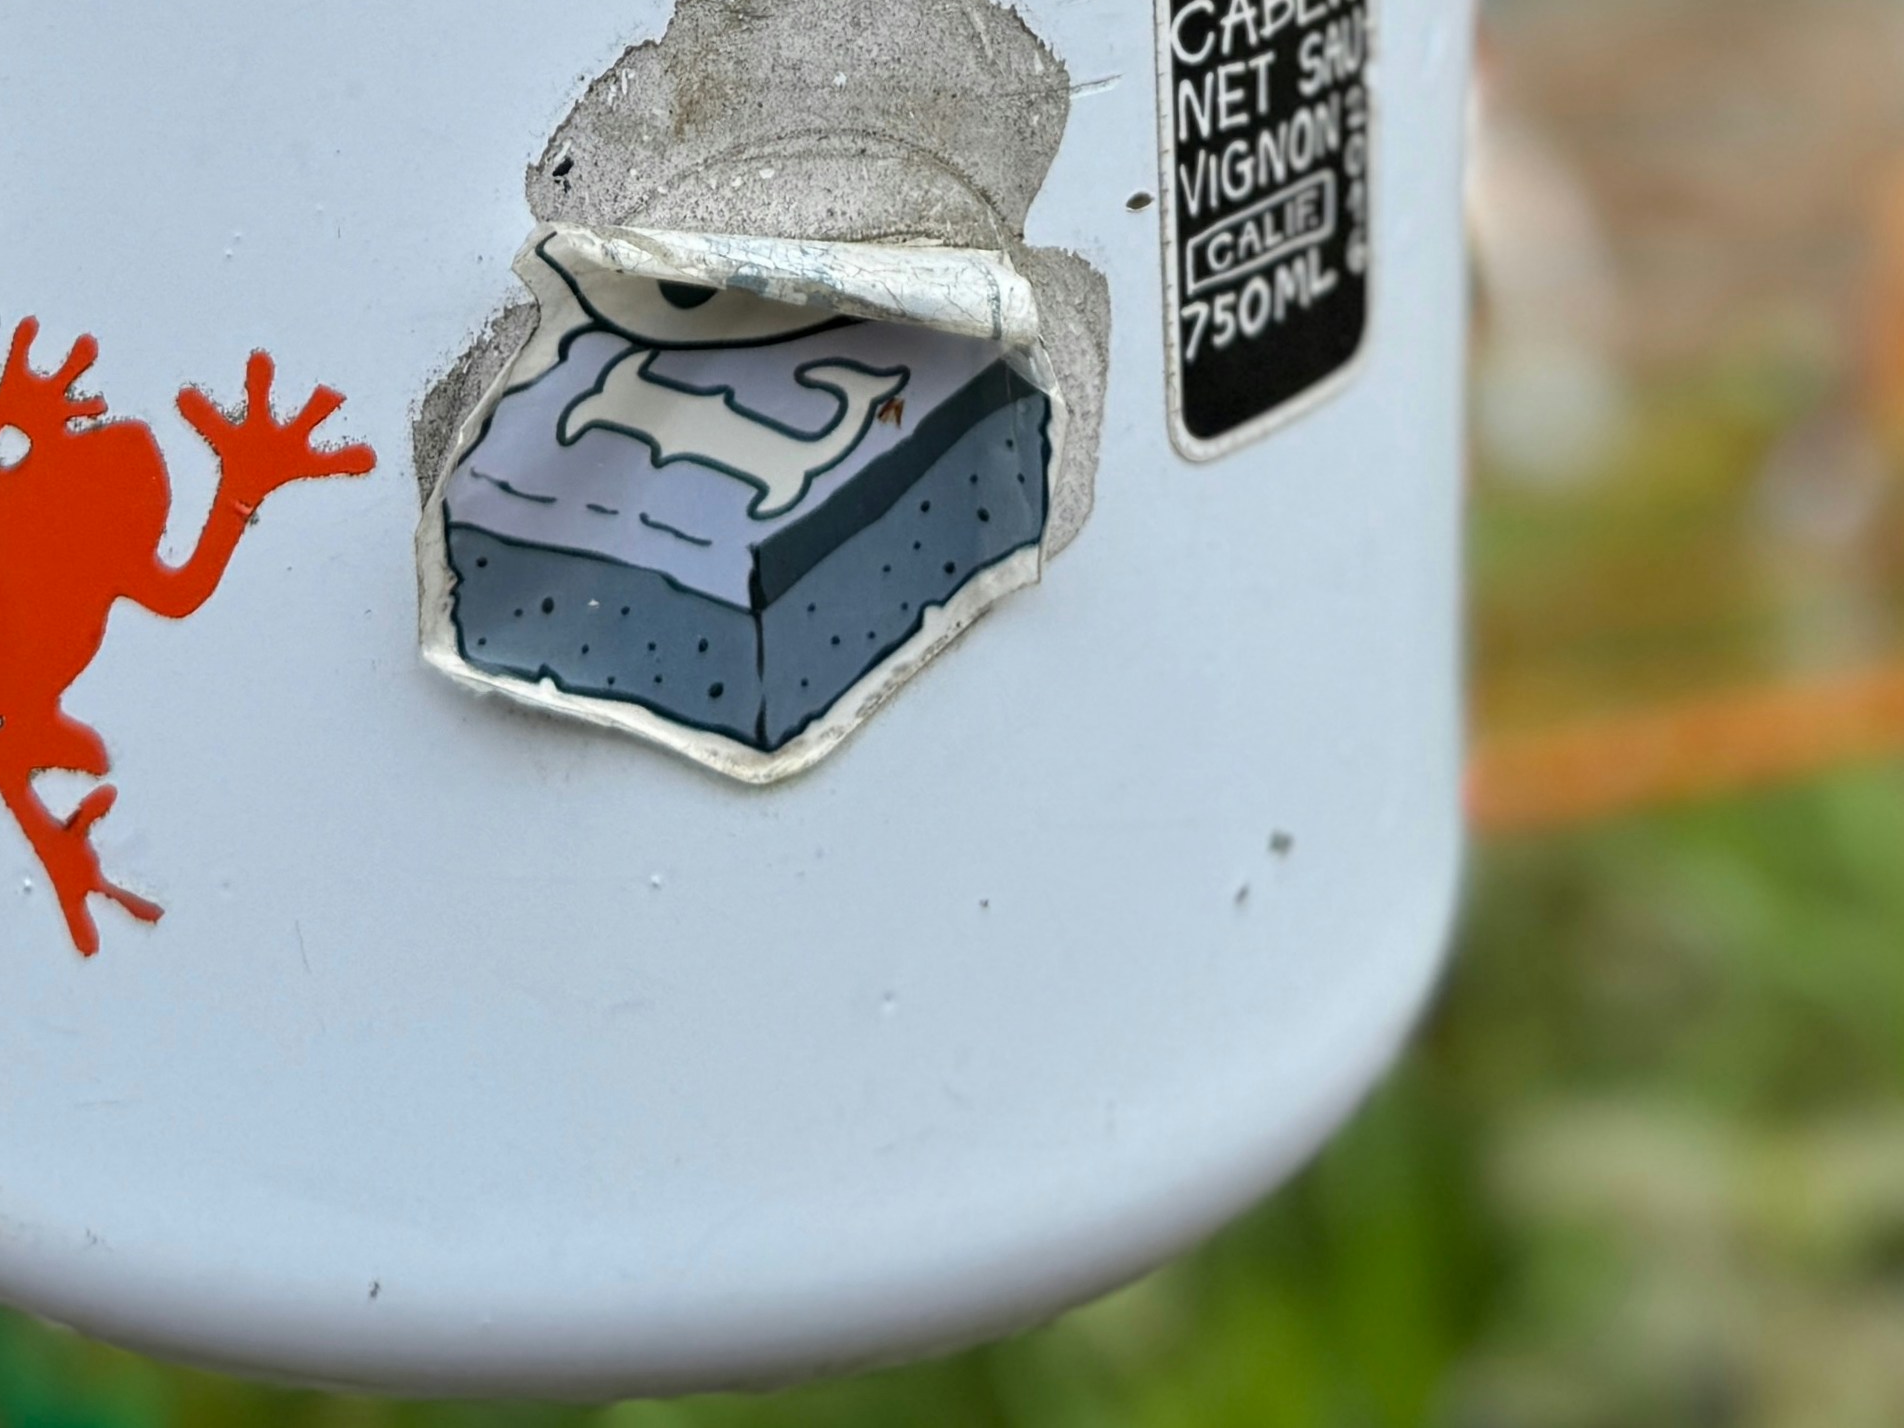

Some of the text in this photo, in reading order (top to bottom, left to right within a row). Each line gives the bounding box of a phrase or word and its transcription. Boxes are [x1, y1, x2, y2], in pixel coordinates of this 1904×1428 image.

[1178, 49, 1276, 143] NET
[1180, 91, 1343, 217] VIGNON
[1179, 243, 1339, 363] 750ML
